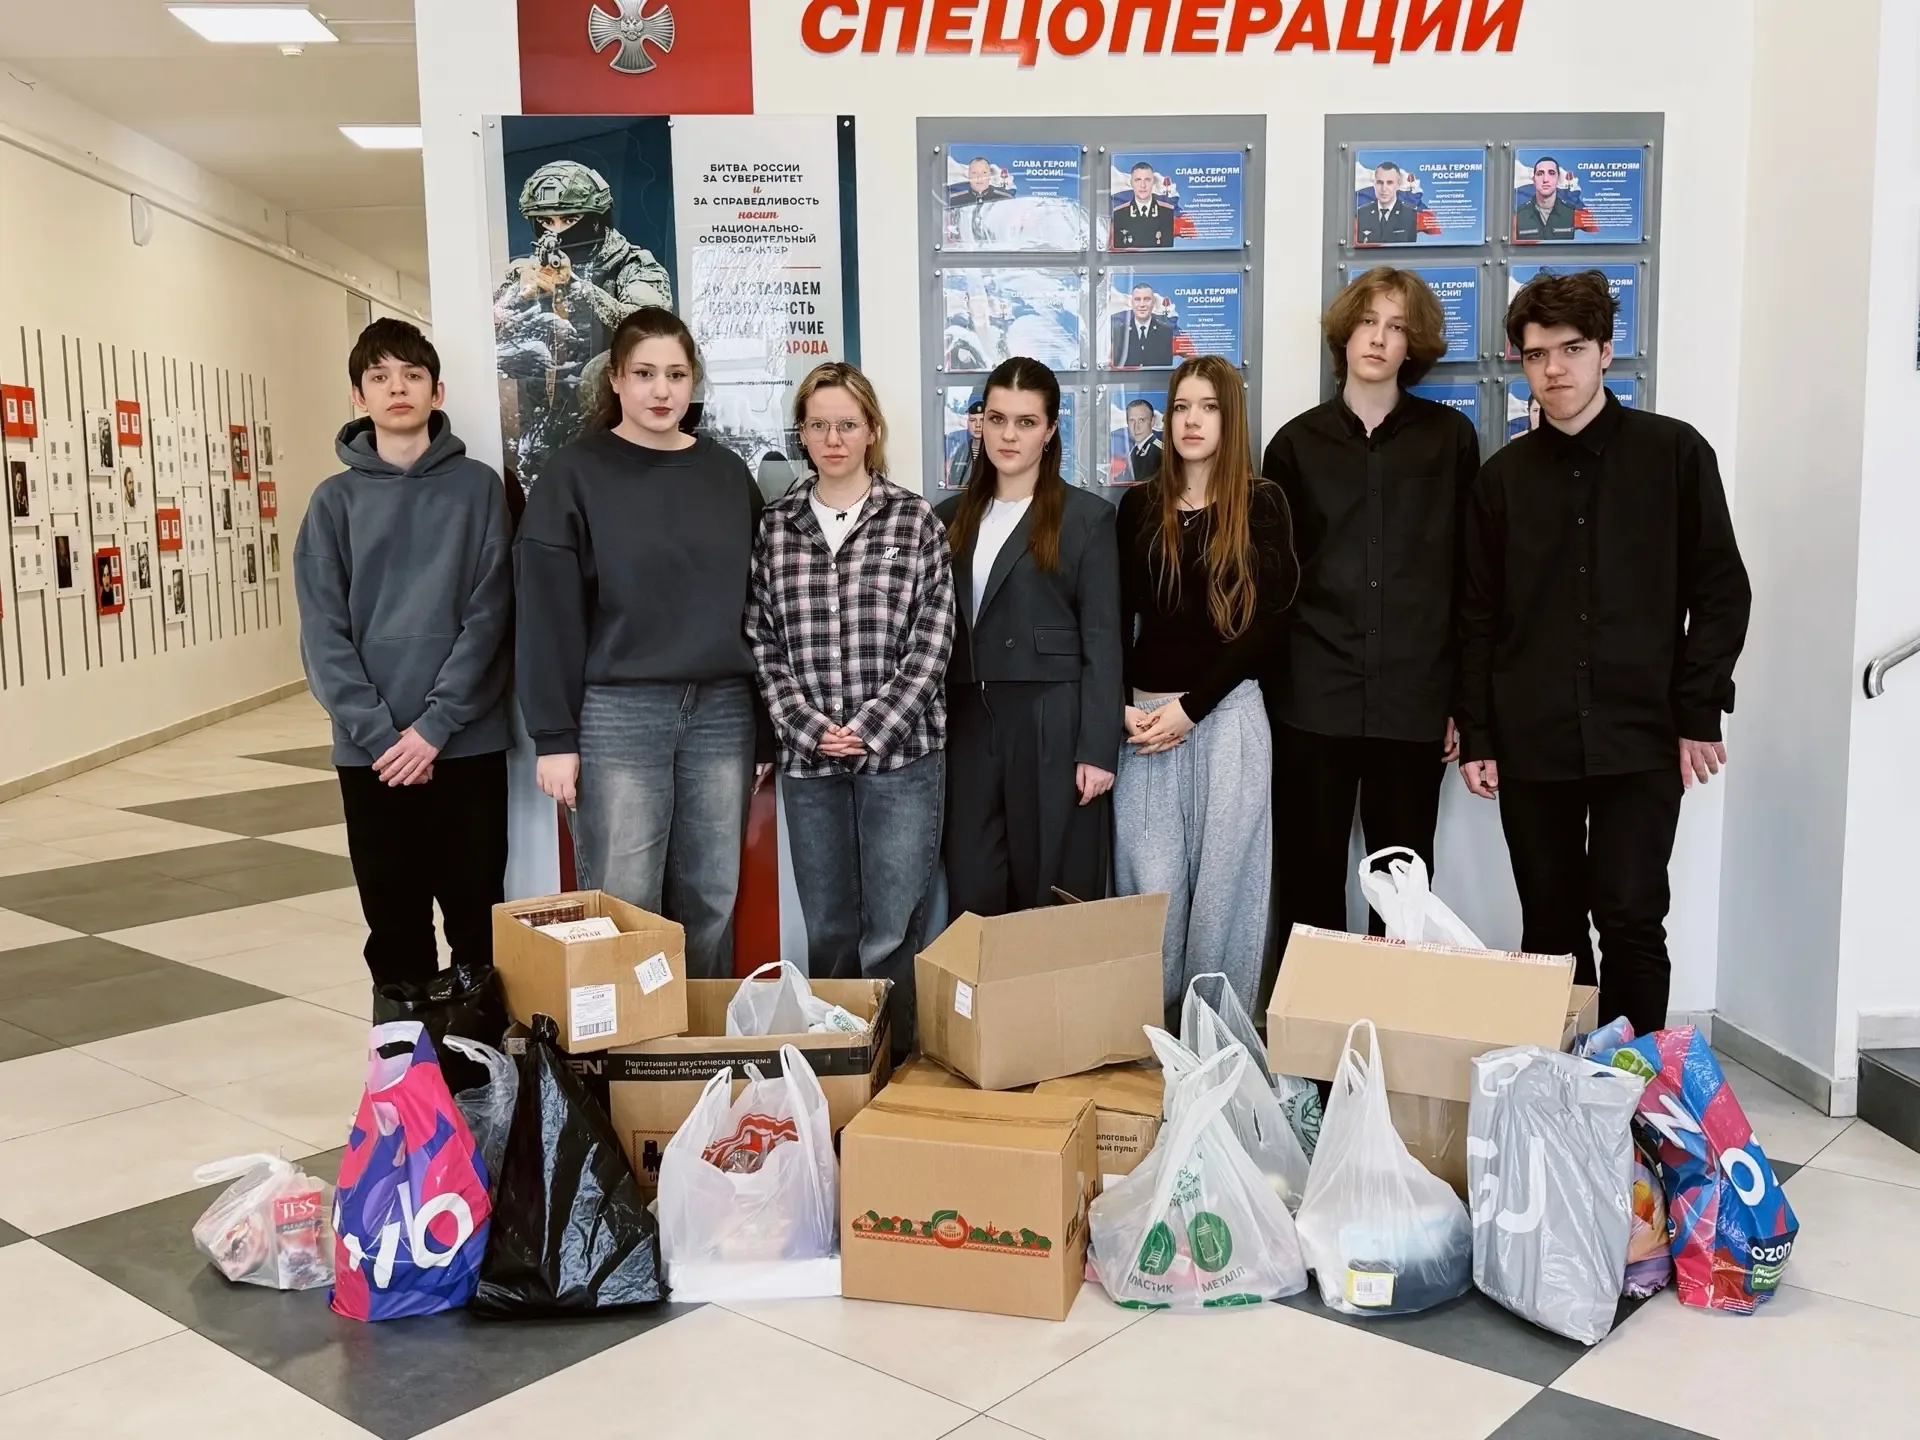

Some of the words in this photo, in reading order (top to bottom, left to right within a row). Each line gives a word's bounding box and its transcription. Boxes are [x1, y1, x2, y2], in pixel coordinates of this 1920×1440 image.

[801, 0, 1524, 66] СПЕЦОПЕРАЦИИ
[710, 164, 748, 172] БИТВА
[753, 164, 800, 172] РОССИИ
[1449, 163, 1483, 171] ГЕРОЯМ
[1607, 162, 1640, 170] ГЕРОЯМ
[703, 174, 717, 182] ЗА
[722, 174, 803, 182] СУВЕРЕНИТЕТ
[693, 197, 708, 205] ЗА
[713, 197, 819, 206] СПРАВЕДЛИВОСТЬ
[738, 211, 779, 219] носит
[712, 225, 803, 233] НАЦИОНАЛЬНО-
[699, 233, 817, 243] ОСВОБОДИТЕЛЬНЫЙ
[1204, 287, 1238, 295] ГЕРОЯМ
[625, 1059, 678, 1069] Портативная
[679, 1058, 736, 1067] акустическая
[737, 1057, 771, 1066] система
[677, 1067, 717, 1077] FM-радио
[1096, 1133, 1138, 1143] алоговый
[1113, 1145, 1138, 1154] пульт
[1751, 1241, 1791, 1262] ozon
[1201, 1266, 1247, 1293] МЕТАЛЛ
